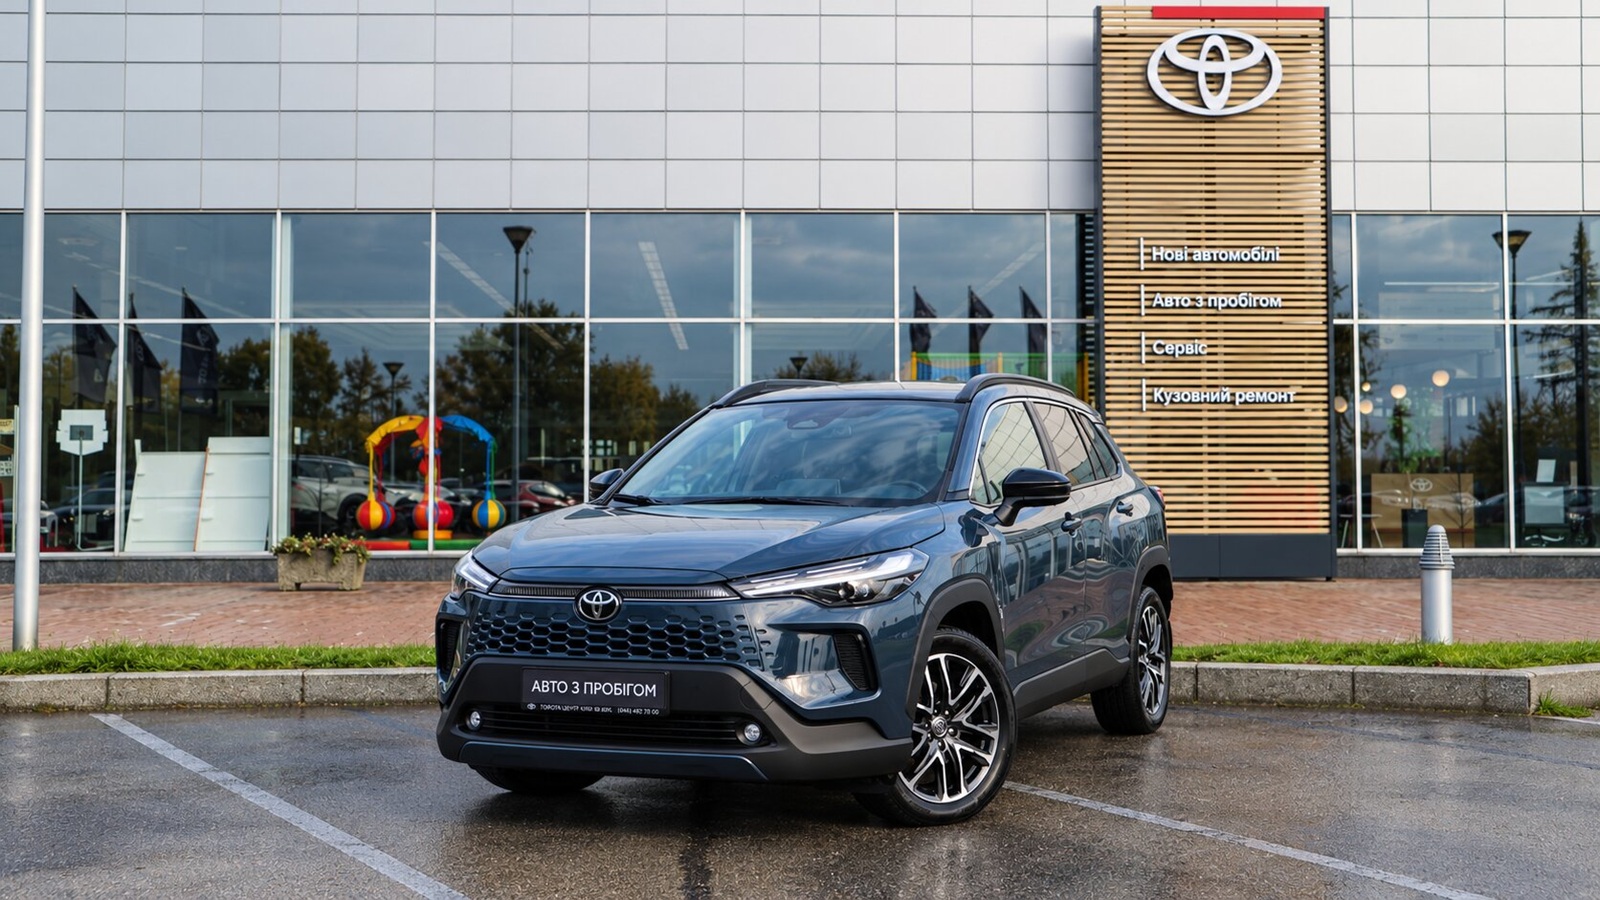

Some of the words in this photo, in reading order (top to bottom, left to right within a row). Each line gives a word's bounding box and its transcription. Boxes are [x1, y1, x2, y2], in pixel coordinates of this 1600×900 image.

[1152, 246, 1187, 261] Нові
[1192, 246, 1280, 261] автомобілі
[1152, 293, 1191, 308] Авто
[1195, 296, 1203, 308] з
[1207, 293, 1282, 310] пробігом
[1152, 339, 1208, 358] Сервіс
[1153, 387, 1231, 406] Кузовний
[1235, 390, 1296, 406] ремонт
[531, 680, 568, 694] АВТО
[583, 681, 657, 697] ПРОБІГОМ
